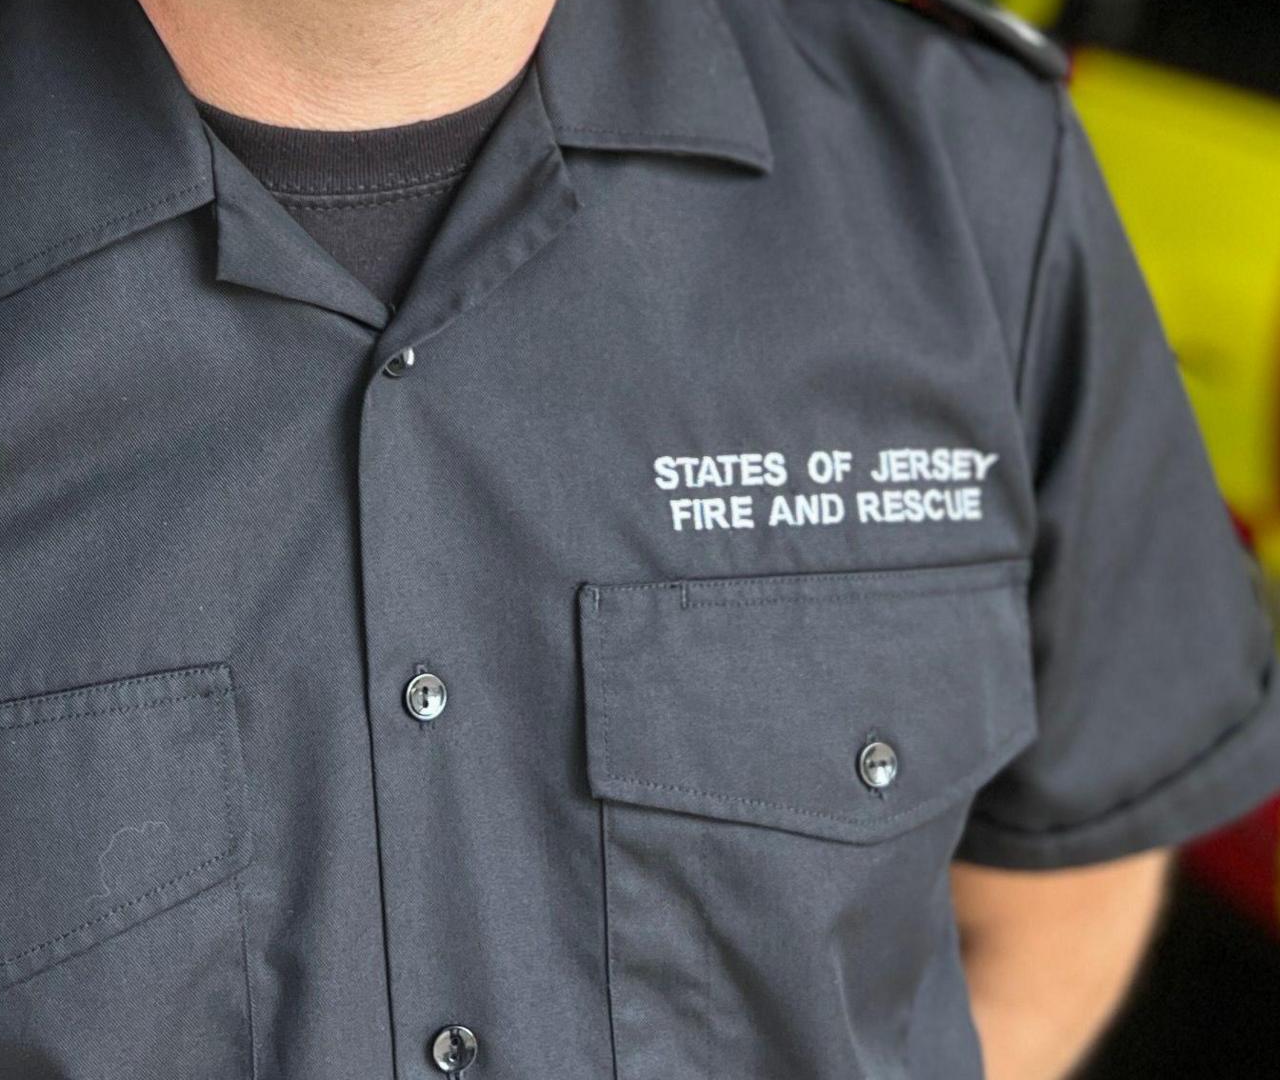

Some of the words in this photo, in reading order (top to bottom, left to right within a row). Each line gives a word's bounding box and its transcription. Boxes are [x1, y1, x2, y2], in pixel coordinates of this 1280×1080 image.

[653, 451, 788, 490] STATES
[807, 450, 853, 484] OF
[870, 447, 1000, 483] JERSEY
[669, 495, 755, 531] FIRE
[768, 493, 846, 527] AND
[855, 487, 983, 524] RESCUE
